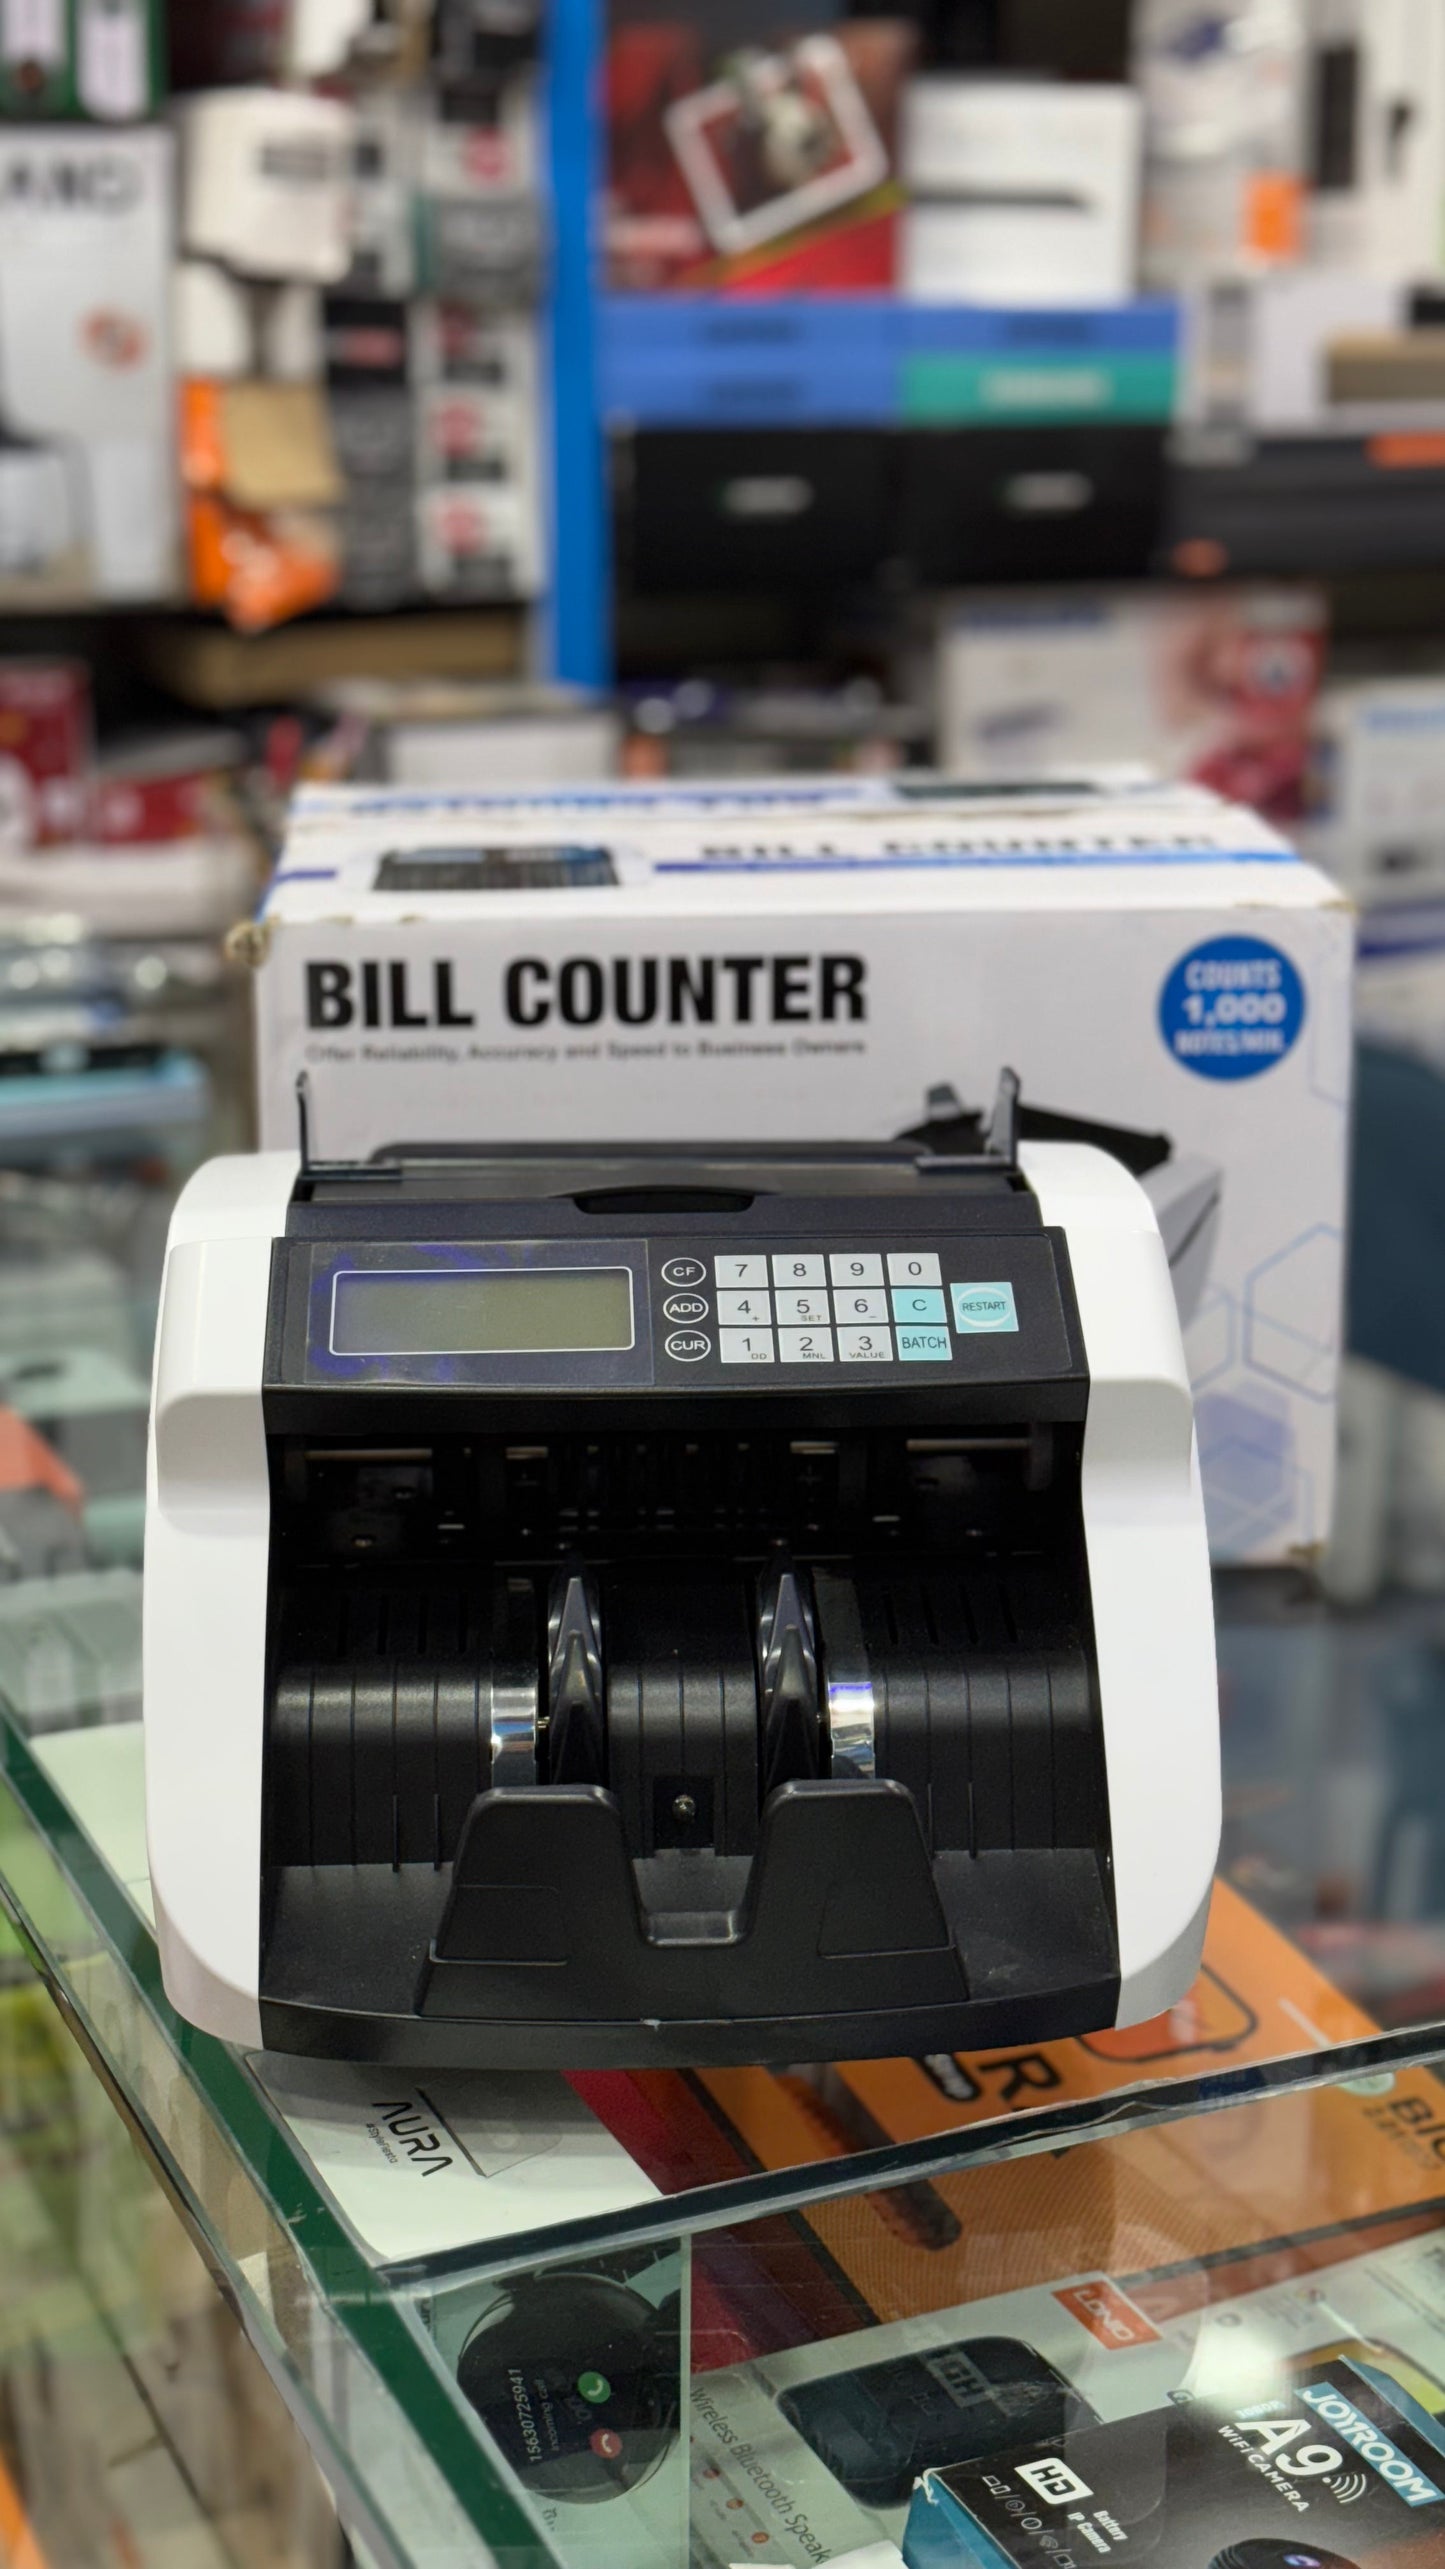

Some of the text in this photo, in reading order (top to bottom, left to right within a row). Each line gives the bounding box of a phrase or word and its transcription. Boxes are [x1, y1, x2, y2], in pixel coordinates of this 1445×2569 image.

[1185, 959, 1282, 991] COUNTS
[306, 953, 866, 1030] BILL COUNTER
[1182, 992, 1287, 1028] 1,000
[566, 1043, 597, 1061] and
[672, 1266, 695, 1277] CF
[735, 1264, 748, 1277] 7
[793, 1264, 806, 1277] 8
[850, 1263, 864, 1276] 9
[908, 1262, 922, 1275] 0
[669, 1303, 702, 1314] ADD
[737, 1301, 750, 1314] 4
[797, 1300, 810, 1314] 5
[854, 1299, 868, 1313] 6
[912, 1299, 927, 1312] C
[962, 1301, 1006, 1312] RESTART
[801, 1314, 821, 1322] SET
[670, 1340, 706, 1351] CUR
[742, 1338, 751, 1351] 1
[799, 1337, 813, 1351] 2
[858, 1336, 872, 1350] 3
[902, 1337, 947, 1349] BATCH
[803, 1352, 826, 1360] MNL
[849, 1351, 886, 1359] VALUE
[372, 2102, 453, 2176] AURA
[508, 2368, 542, 2462] 15630725941
[1233, 2419, 1343, 2476] A9
[1303, 2390, 1438, 2502] JOYROOM
[690, 2387, 738, 2446] Wireless
[731, 2443, 794, 2515] Bluetooth
[785, 2513, 833, 2563] Speak
[1030, 2465, 1076, 2497] HD
[1248, 2453, 1310, 2512] CAMERA
[1067, 2511, 1112, 2554] IP Camera
[1093, 2510, 1128, 2541] Battery
